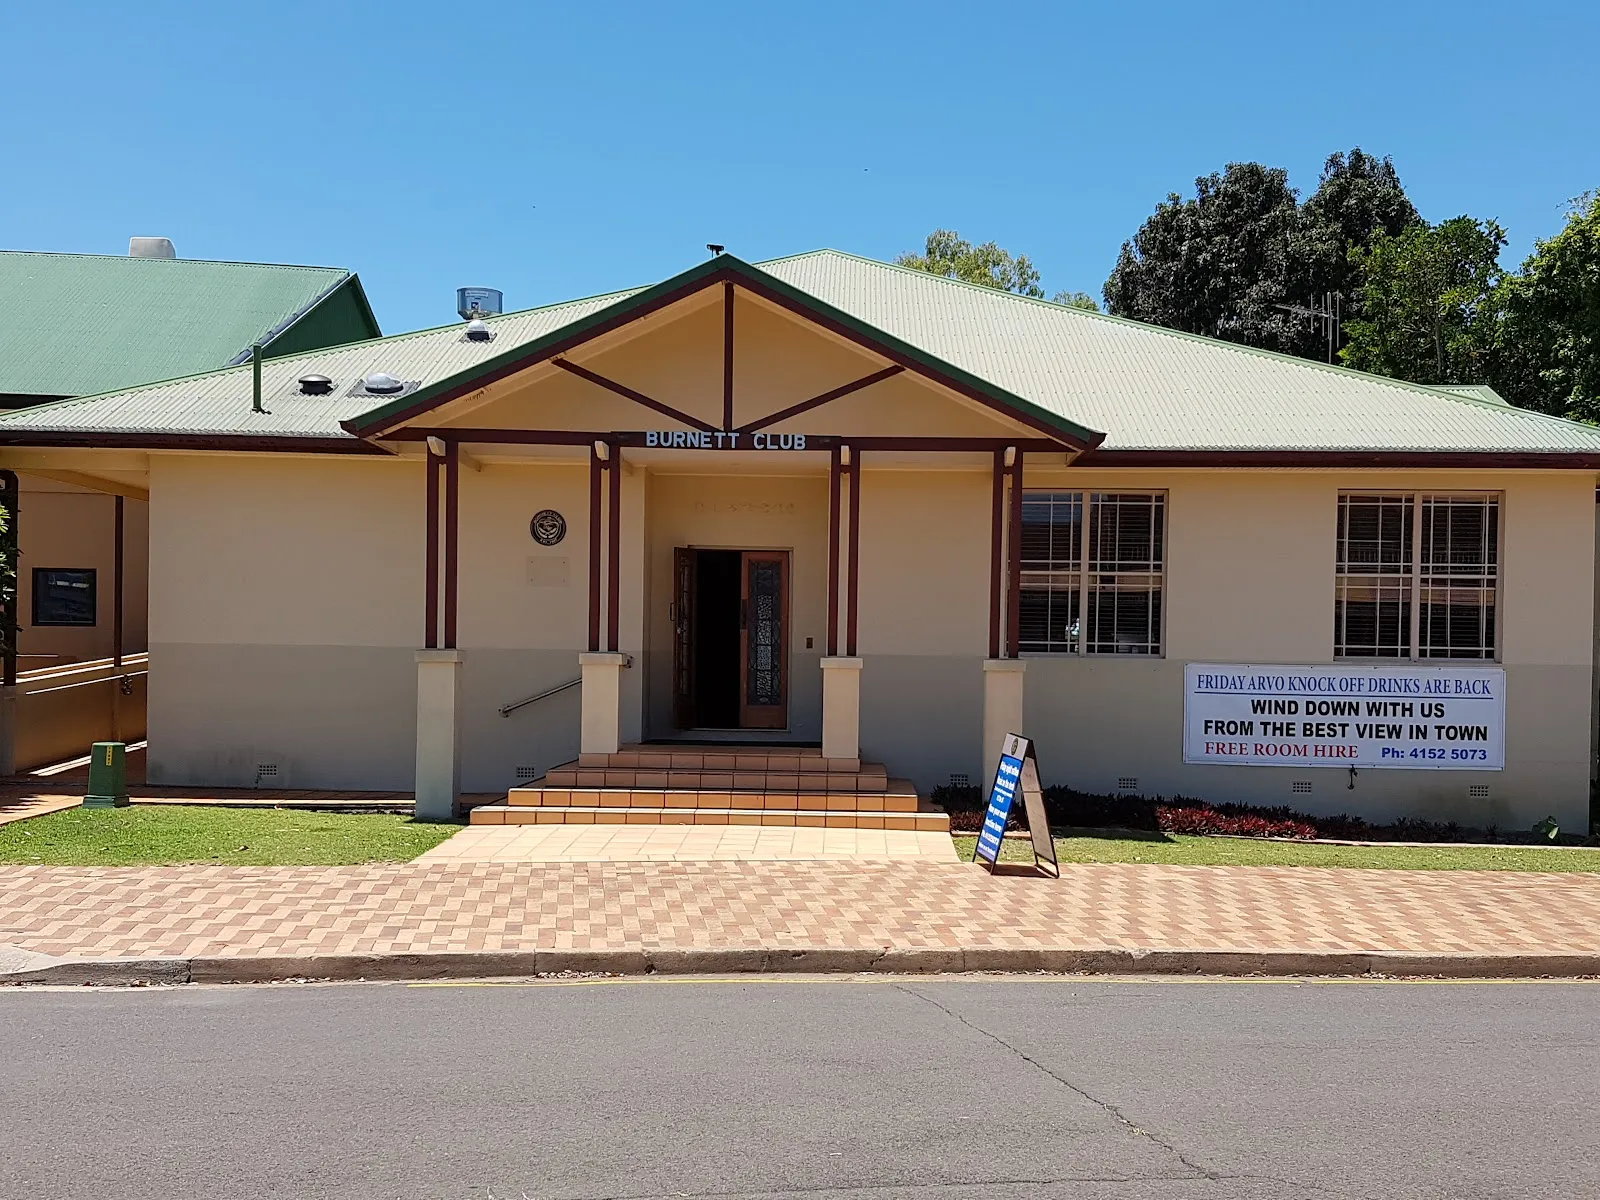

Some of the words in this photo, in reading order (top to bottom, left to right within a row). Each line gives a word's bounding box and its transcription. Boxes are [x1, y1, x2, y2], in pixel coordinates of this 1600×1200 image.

[646, 431, 740, 449] BURNETT
[753, 433, 806, 450] CLUB
[1197, 674, 1246, 690] FRIDAY
[1247, 675, 1285, 691] ARVO
[1288, 676, 1336, 692] KNOCK
[1339, 677, 1365, 692] OFF
[1368, 677, 1420, 694] DRINKS
[1423, 679, 1451, 694] ARE
[1454, 680, 1492, 695] BACK
[1251, 699, 1299, 715] WIND
[1305, 700, 1360, 716] DOWN
[1366, 701, 1414, 718] WITH
[1420, 702, 1445, 718] US
[1204, 719, 1254, 736] FROM
[1260, 721, 1296, 737] THE
[1302, 722, 1350, 738] BEST
[1355, 723, 1403, 740] VIEW
[1409, 724, 1428, 740] IN
[1434, 725, 1488, 741] TOWN
[1204, 741, 1249, 756] FREE
[1253, 742, 1308, 757] ROOM
[1312, 744, 1359, 758] HIRE
[1381, 747, 1405, 759] Ph:
[1409, 747, 1446, 760] 4152
[1450, 748, 1487, 760] 5073
